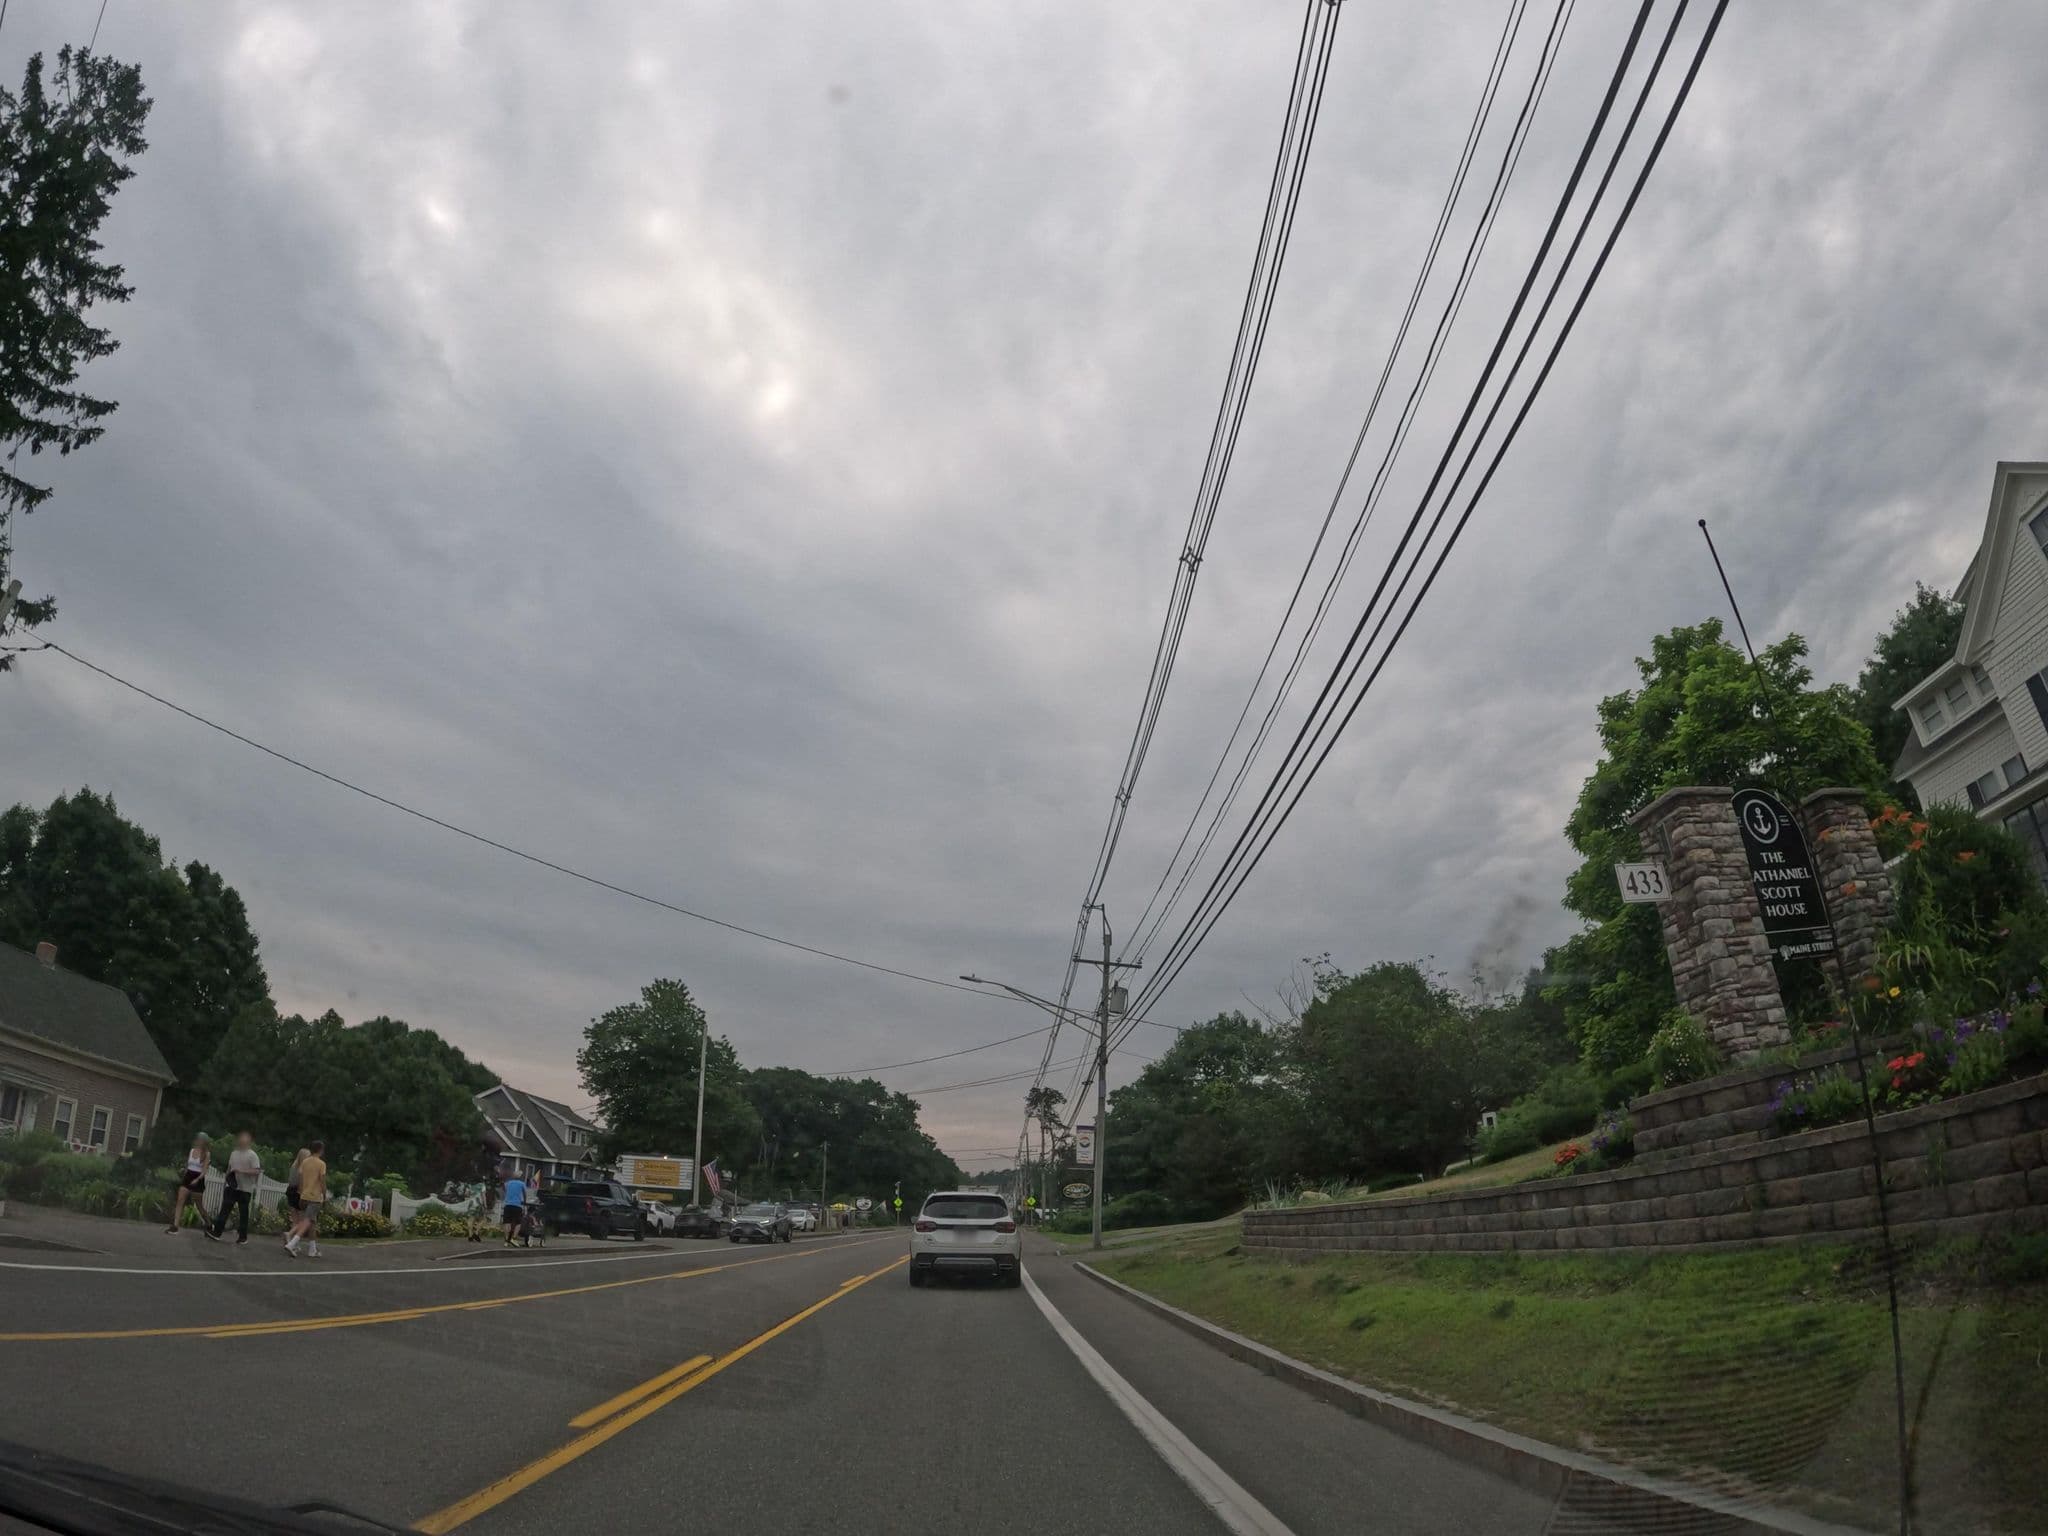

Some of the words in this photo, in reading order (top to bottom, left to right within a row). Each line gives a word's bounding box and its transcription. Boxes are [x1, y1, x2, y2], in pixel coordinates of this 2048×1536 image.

[1760, 851, 1786, 864] THE
[1753, 867, 1812, 882] ATHANIEL
[1626, 870, 1664, 895] 433
[1761, 885, 1801, 900] SCOTT
[1766, 903, 1808, 917] HOUSE
[1789, 943, 1811, 954] MAINE
[1812, 941, 1834, 952] STREET
